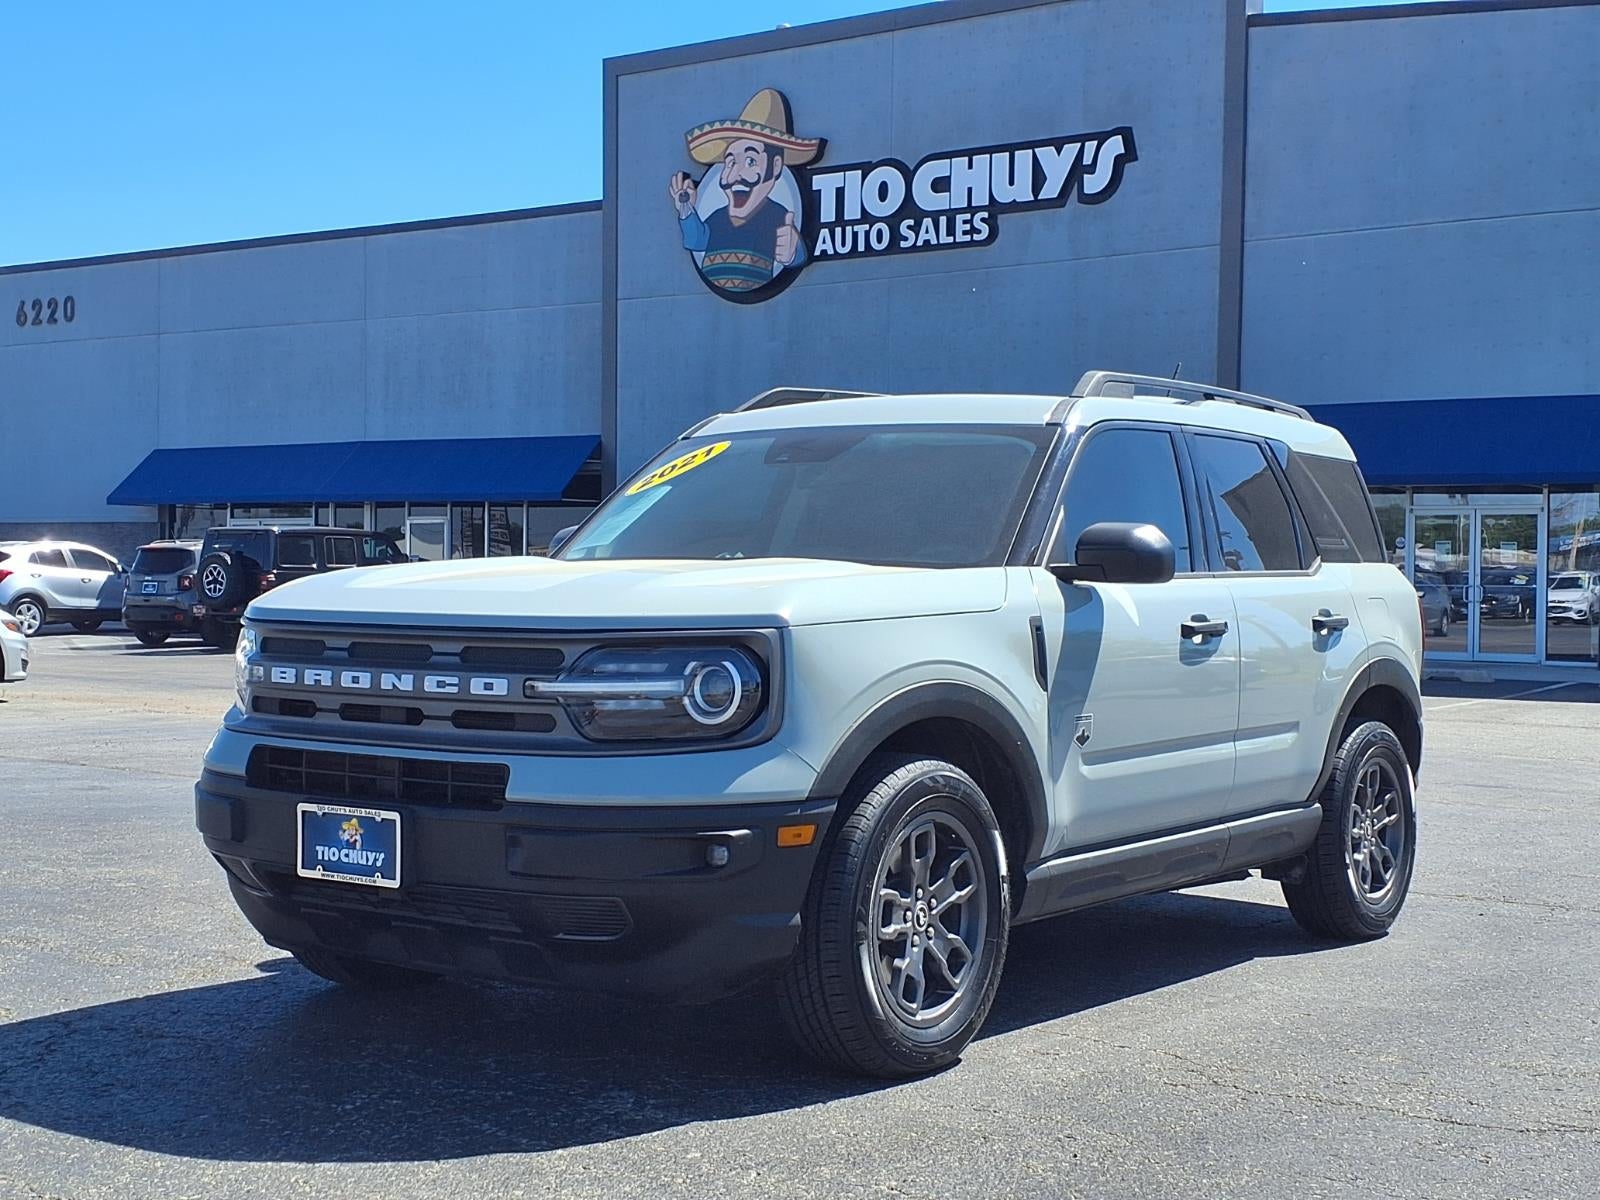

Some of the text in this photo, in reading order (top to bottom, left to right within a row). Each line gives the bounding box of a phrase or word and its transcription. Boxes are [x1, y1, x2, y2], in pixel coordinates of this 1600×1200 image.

[812, 135, 1125, 223] TIO CHUY'S
[814, 212, 989, 256] AUTO SALES
[16, 295, 75, 327] 6220
[635, 445, 716, 491] 2021
[271, 667, 508, 695] BRONCO
[315, 845, 385, 867] TIO CHUY'S
